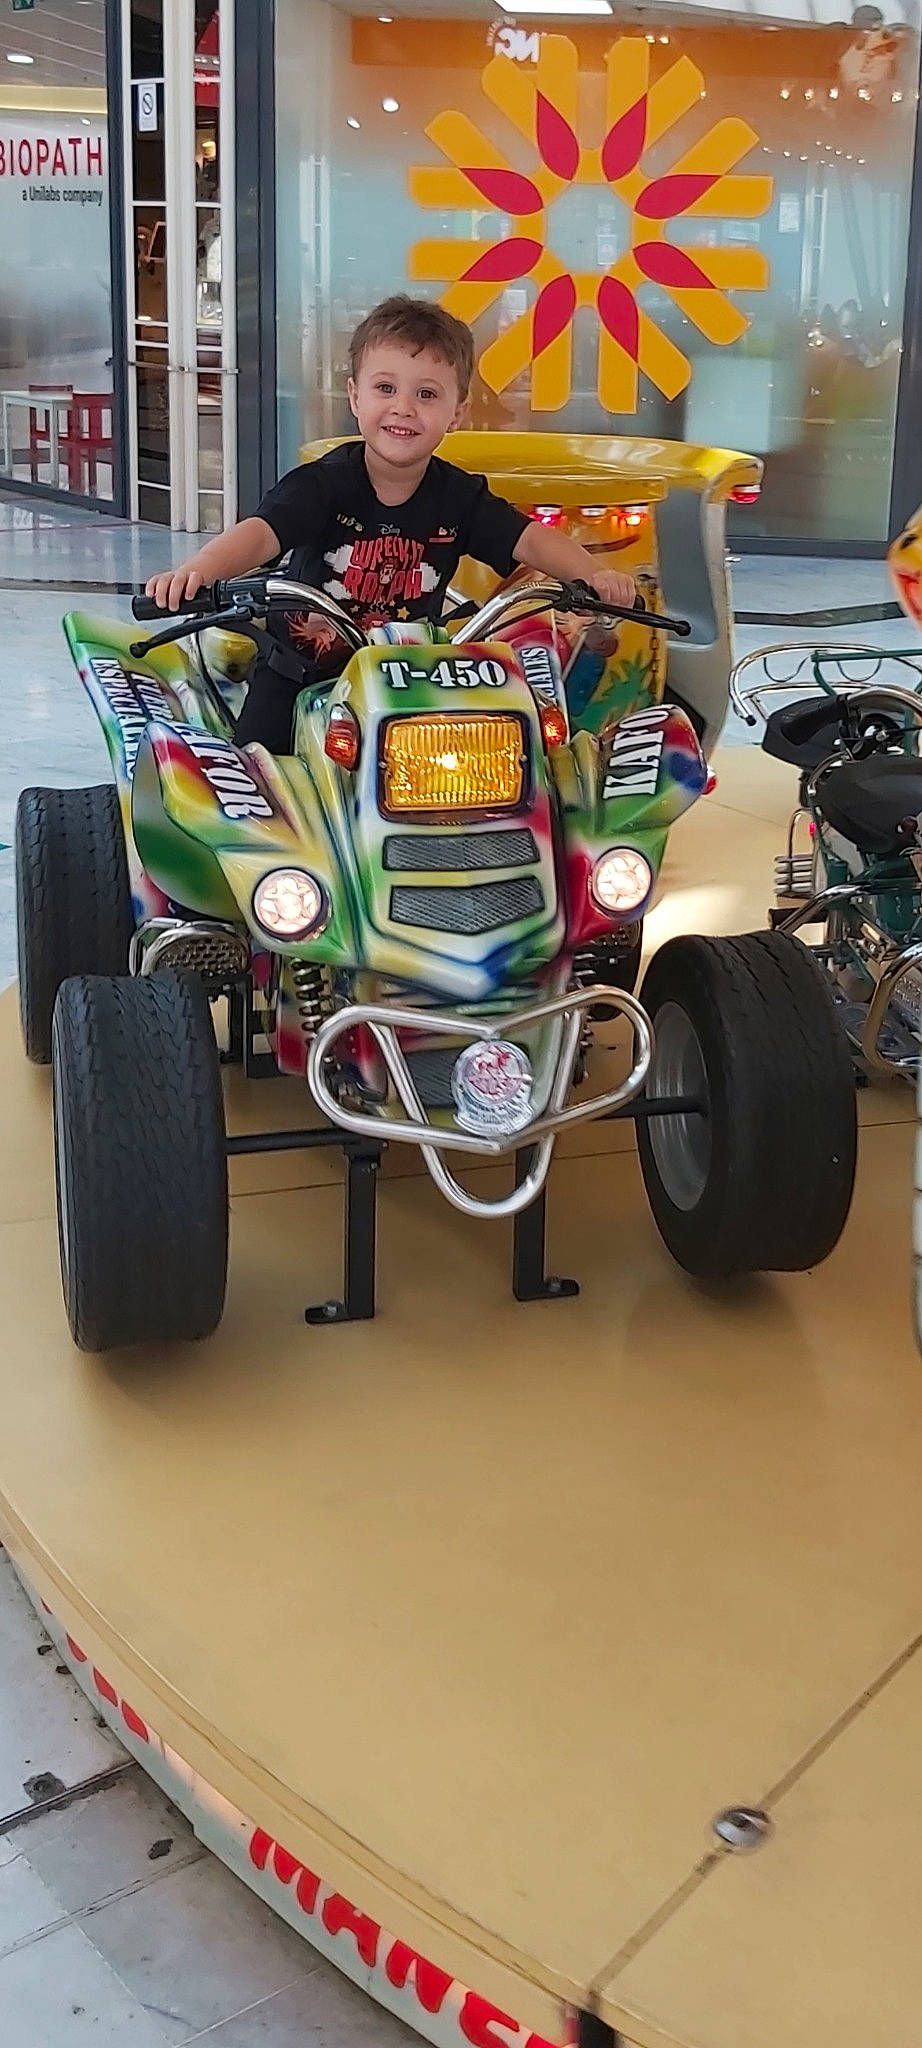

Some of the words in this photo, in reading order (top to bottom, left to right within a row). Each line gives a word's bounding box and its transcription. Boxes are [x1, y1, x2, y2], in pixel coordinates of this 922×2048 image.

[22, 190, 27, 201] a
[29, 185, 61, 201] Unilabs
[62, 189, 103, 207] company
[381, 659, 507, 689] T-450
[163, 721, 272, 819] AFOR
[602, 704, 676, 800] KAFO
